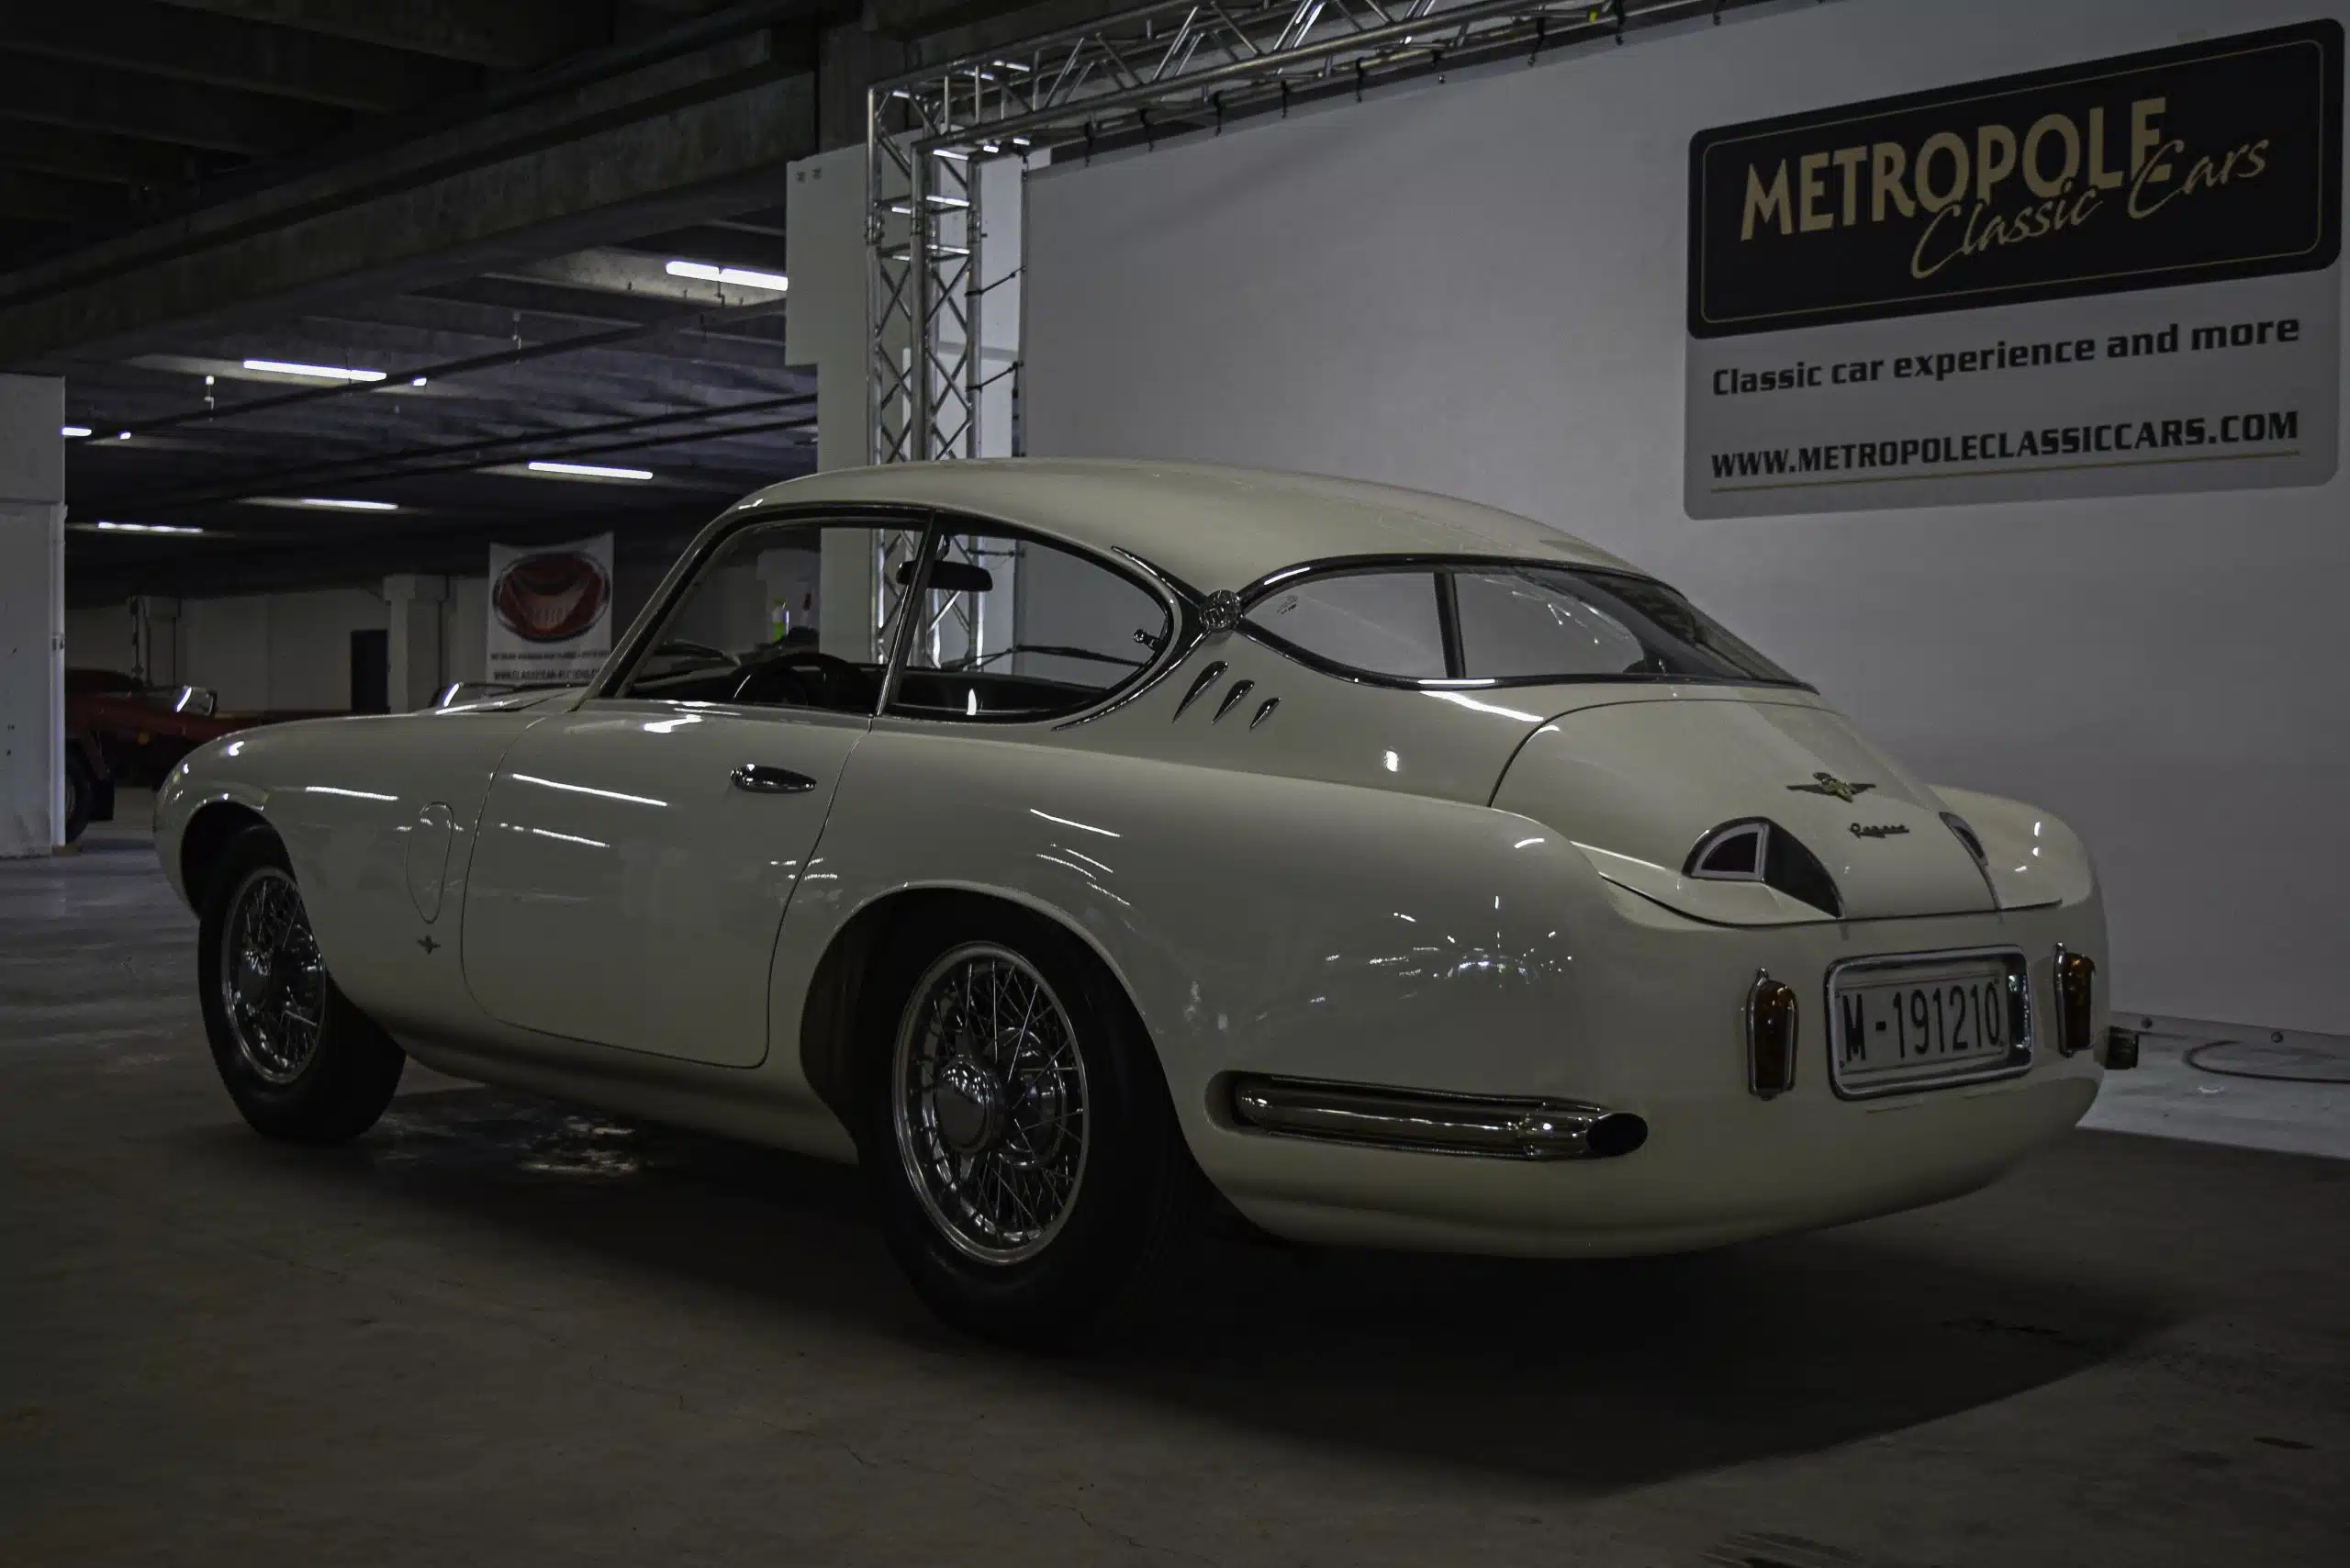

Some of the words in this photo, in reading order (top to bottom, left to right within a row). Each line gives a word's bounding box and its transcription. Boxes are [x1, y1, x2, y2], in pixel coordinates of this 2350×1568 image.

[1740, 96, 2173, 241] METROPOLE
[1910, 179, 2104, 279] Classic
[2126, 139, 2269, 219] Cars
[1713, 362, 1822, 396] Classic
[1831, 360, 1884, 384] car
[1893, 339, 2096, 381] experience
[2107, 324, 2179, 358] and
[2191, 319, 2300, 351] more
[1712, 411, 2299, 477] WWW.METROPOLECLASSICCARS.COM
[1843, 982, 2000, 1061] M-191210
